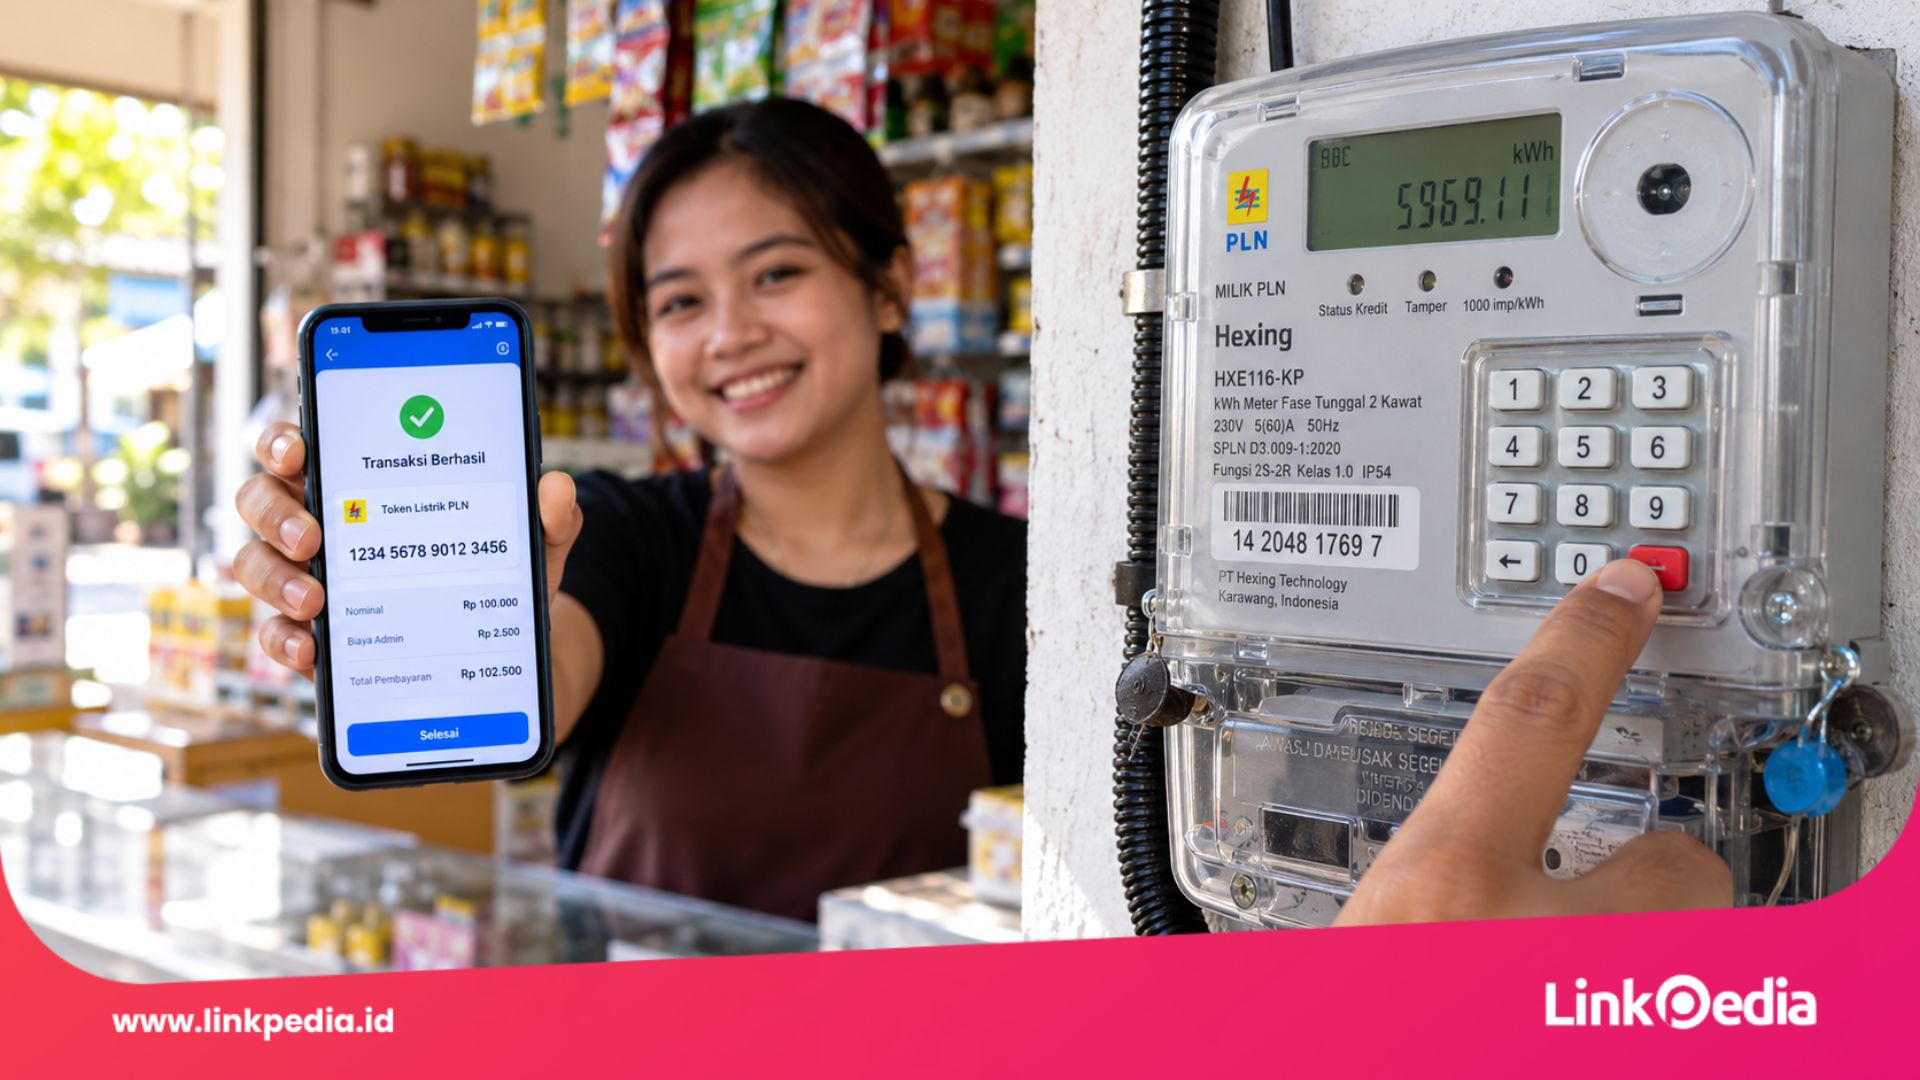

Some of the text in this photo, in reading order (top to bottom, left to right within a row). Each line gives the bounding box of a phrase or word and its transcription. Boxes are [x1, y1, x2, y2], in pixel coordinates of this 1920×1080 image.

[1513, 140, 1554, 164] kWh
[1226, 230, 1268, 253] PLN
[1215, 281, 1286, 299] MILIK PLN
[1318, 301, 1388, 317] Status Kredit
[1405, 300, 1448, 315] Tamper
[1463, 297, 1545, 313] 1000 imp/kWh
[1215, 322, 1292, 351] Hexing
[1214, 368, 1304, 387] HXE116-KP
[1577, 377, 1592, 400] 2
[1652, 375, 1666, 400] 3
[1509, 378, 1518, 401] 1
[1214, 394, 1422, 412] kWh Meter Fase Tunggal 2 Kawat
[1214, 418, 1340, 435] 230V 5(60)A 50Hz
[1213, 441, 1341, 456] SPLN D3.009-1:2020
[1505, 435, 1520, 458] 4
[1576, 435, 1591, 459] 5
[1650, 435, 1665, 459] 6
[362, 451, 486, 470] Transaksi Berhasil
[1213, 463, 1392, 480] Fungsi 2S-2R Kelas 1.0 IP54
[381, 500, 469, 515] Token Listrik PLN
[1505, 492, 1518, 515] 7
[1575, 494, 1589, 517] 8
[1649, 496, 1664, 520] 9
[350, 540, 508, 562] 1234 5678 9012 3456
[1233, 529, 1383, 558] 14 2048 1769 7
[1573, 552, 1588, 576] 0
[1219, 570, 1348, 594] PT Hexing Technology
[346, 597, 519, 616] Nominal Rp 100.000
[1219, 590, 1339, 610] Karawang, Indonesia
[347, 627, 520, 647] Biaya Admin Rp 2.500
[350, 665, 522, 687] Total Pembayaran Rp 102.500
[419, 727, 460, 741] Selesai
